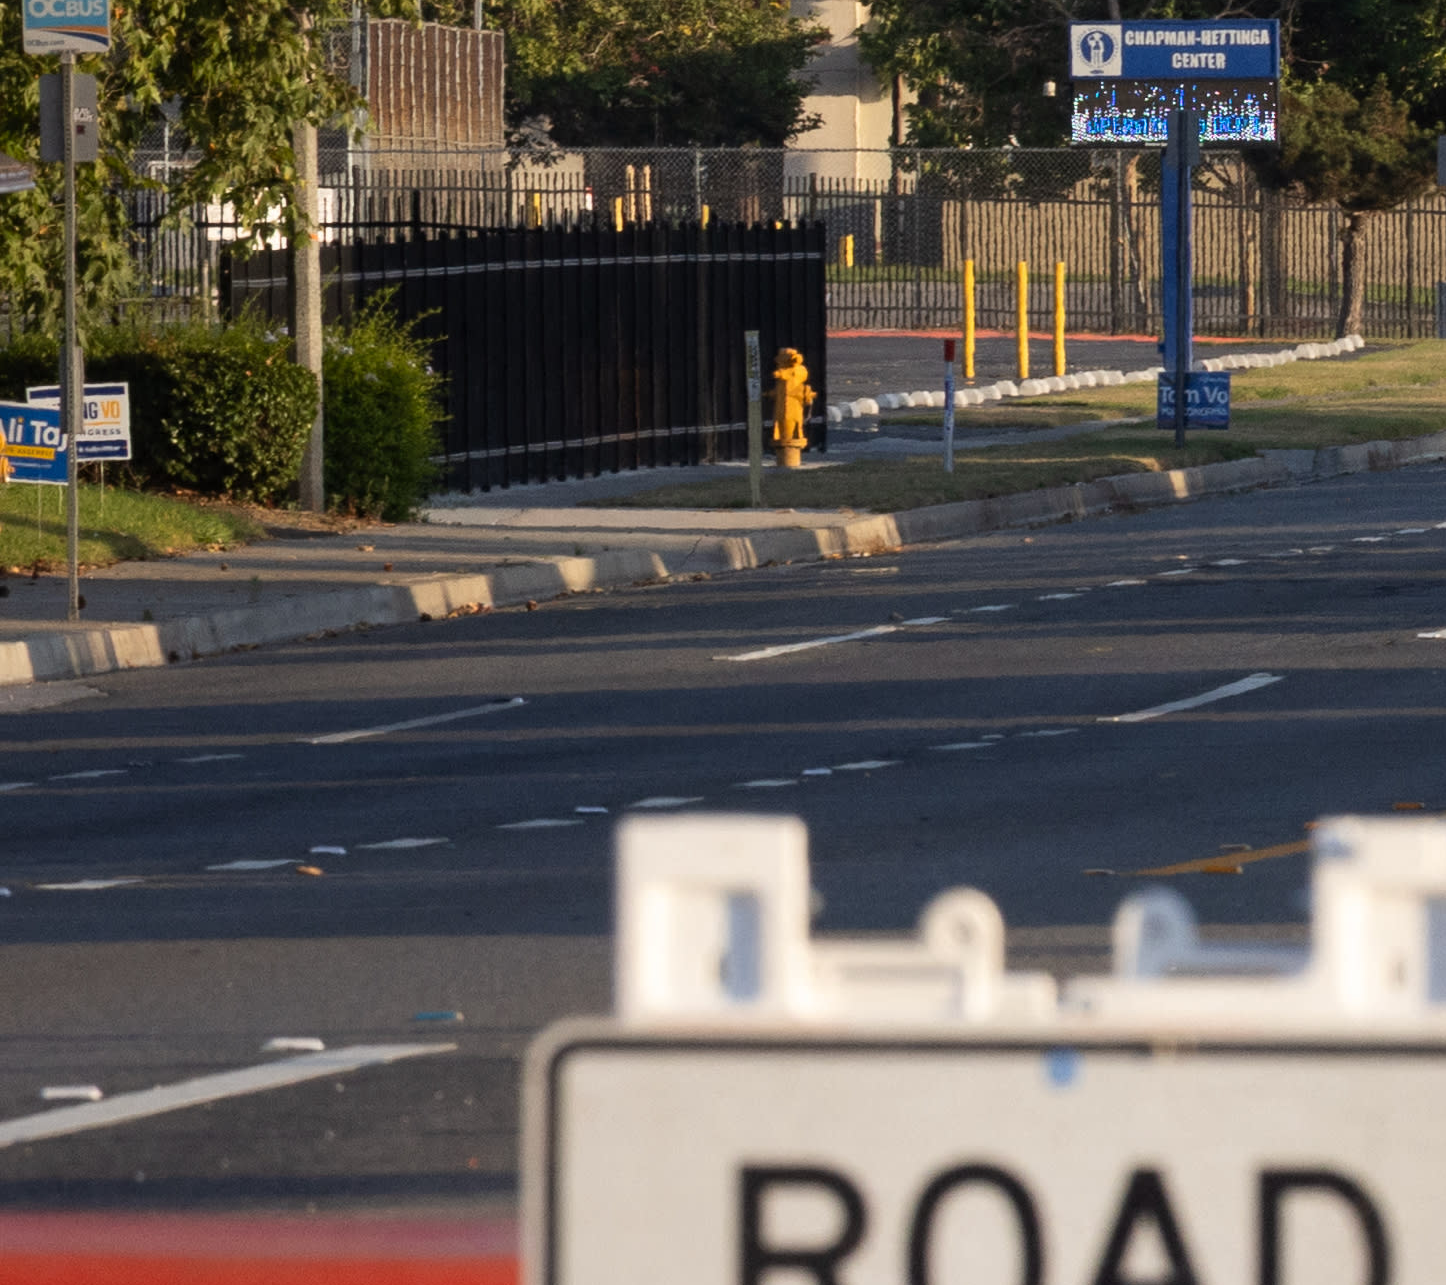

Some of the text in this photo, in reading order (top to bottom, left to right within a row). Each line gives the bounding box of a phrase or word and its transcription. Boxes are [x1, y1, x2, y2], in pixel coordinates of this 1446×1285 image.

[1125, 29, 1270, 46] CHAPMAN-HETTINGA
[1172, 53, 1226, 69] CENTER
[1203, 386, 1228, 404] Vo
[101, 400, 121, 418] VO
[30, 420, 69, 452] Taj
